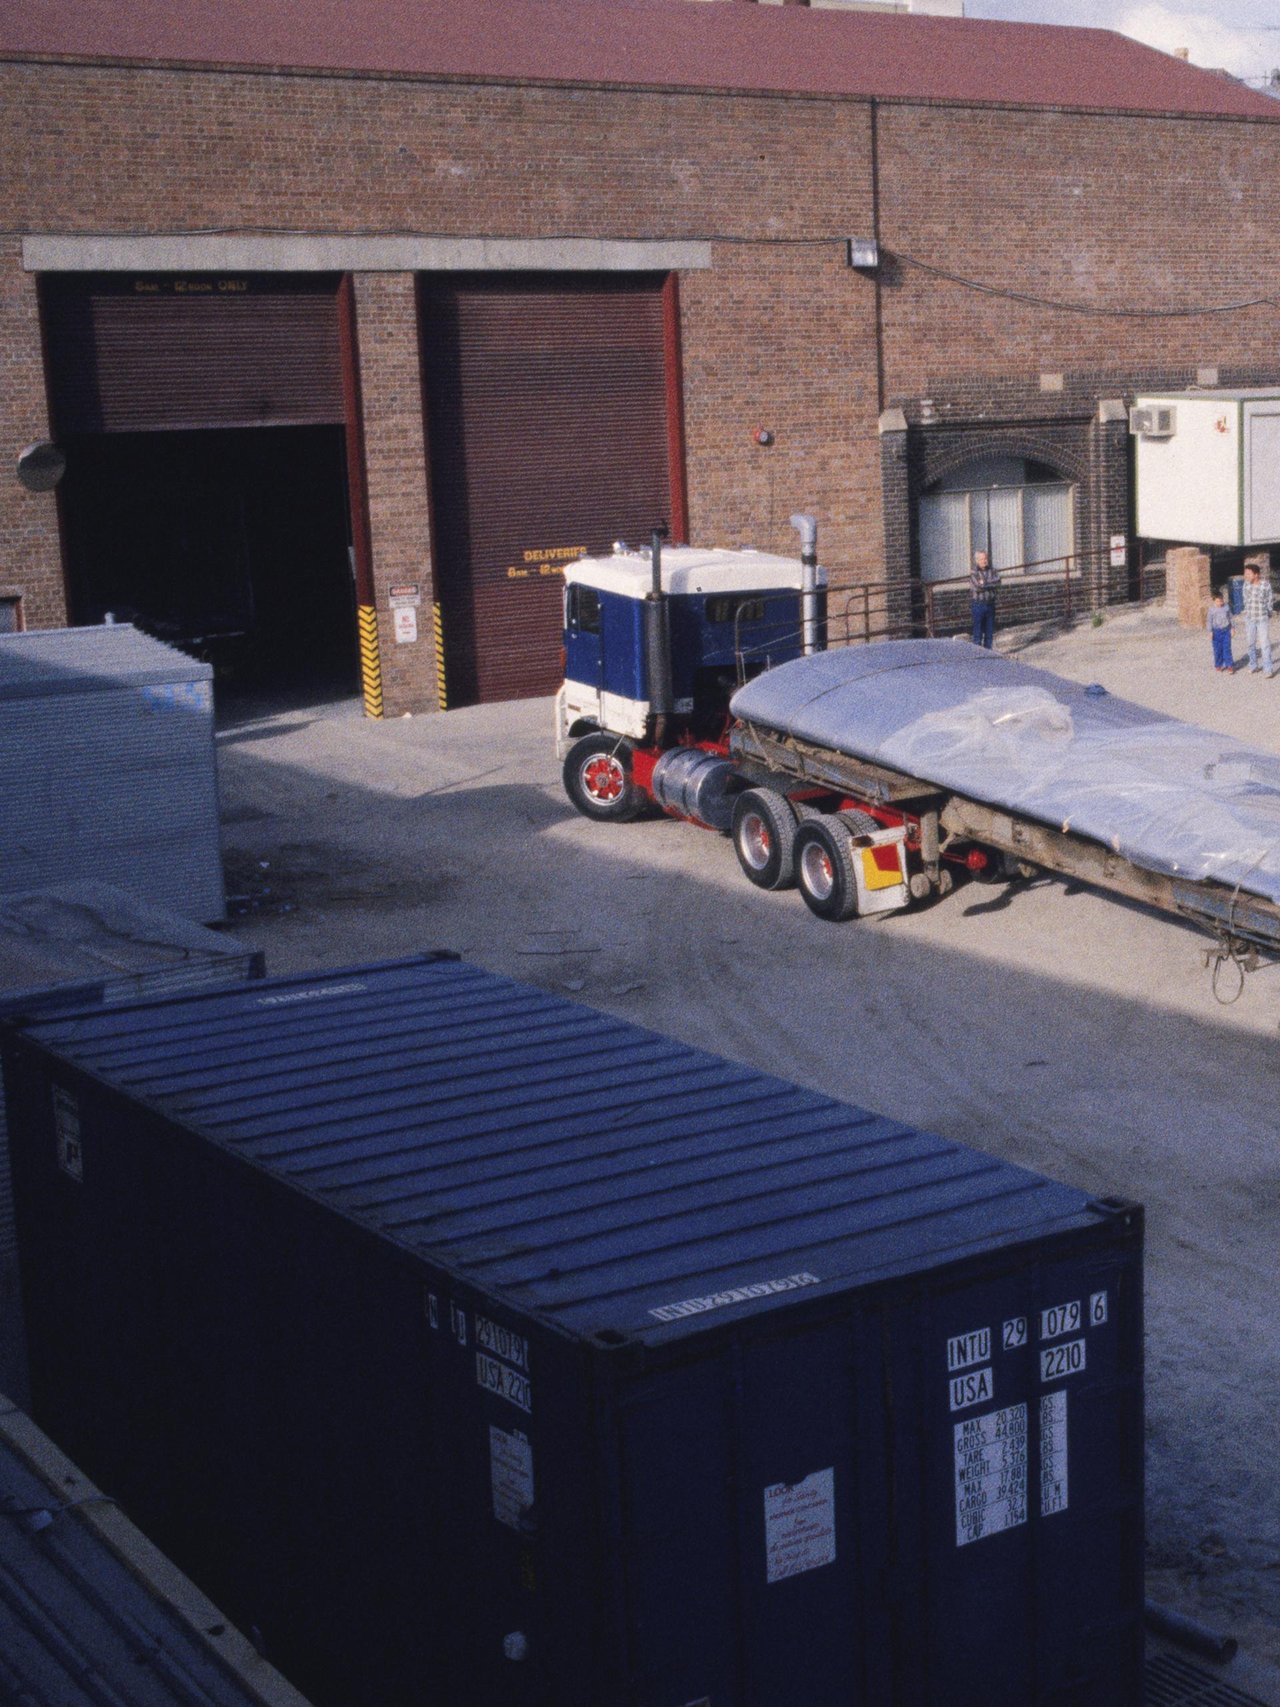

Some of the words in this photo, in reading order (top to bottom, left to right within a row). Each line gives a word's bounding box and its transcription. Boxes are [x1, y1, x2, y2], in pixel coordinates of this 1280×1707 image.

[217, 280, 248, 291] ONLY
[950, 1332, 988, 1366] INTU
[1004, 1318, 1026, 1348] 29
[1094, 1296, 1104, 1321] 6
[1045, 1343, 1082, 1378] 2210
[480, 1356, 505, 1391] USA
[954, 1374, 989, 1407] USA
[963, 1420, 981, 1436] MAX
[957, 1431, 986, 1451] GROSS
[964, 1449, 983, 1466] TARE
[959, 1460, 990, 1481] WEIGHT
[964, 1480, 982, 1496] MAX
[959, 1491, 987, 1512] CARGO
[961, 1509, 986, 1529] CUBIC
[967, 1524, 984, 1541] CAP
